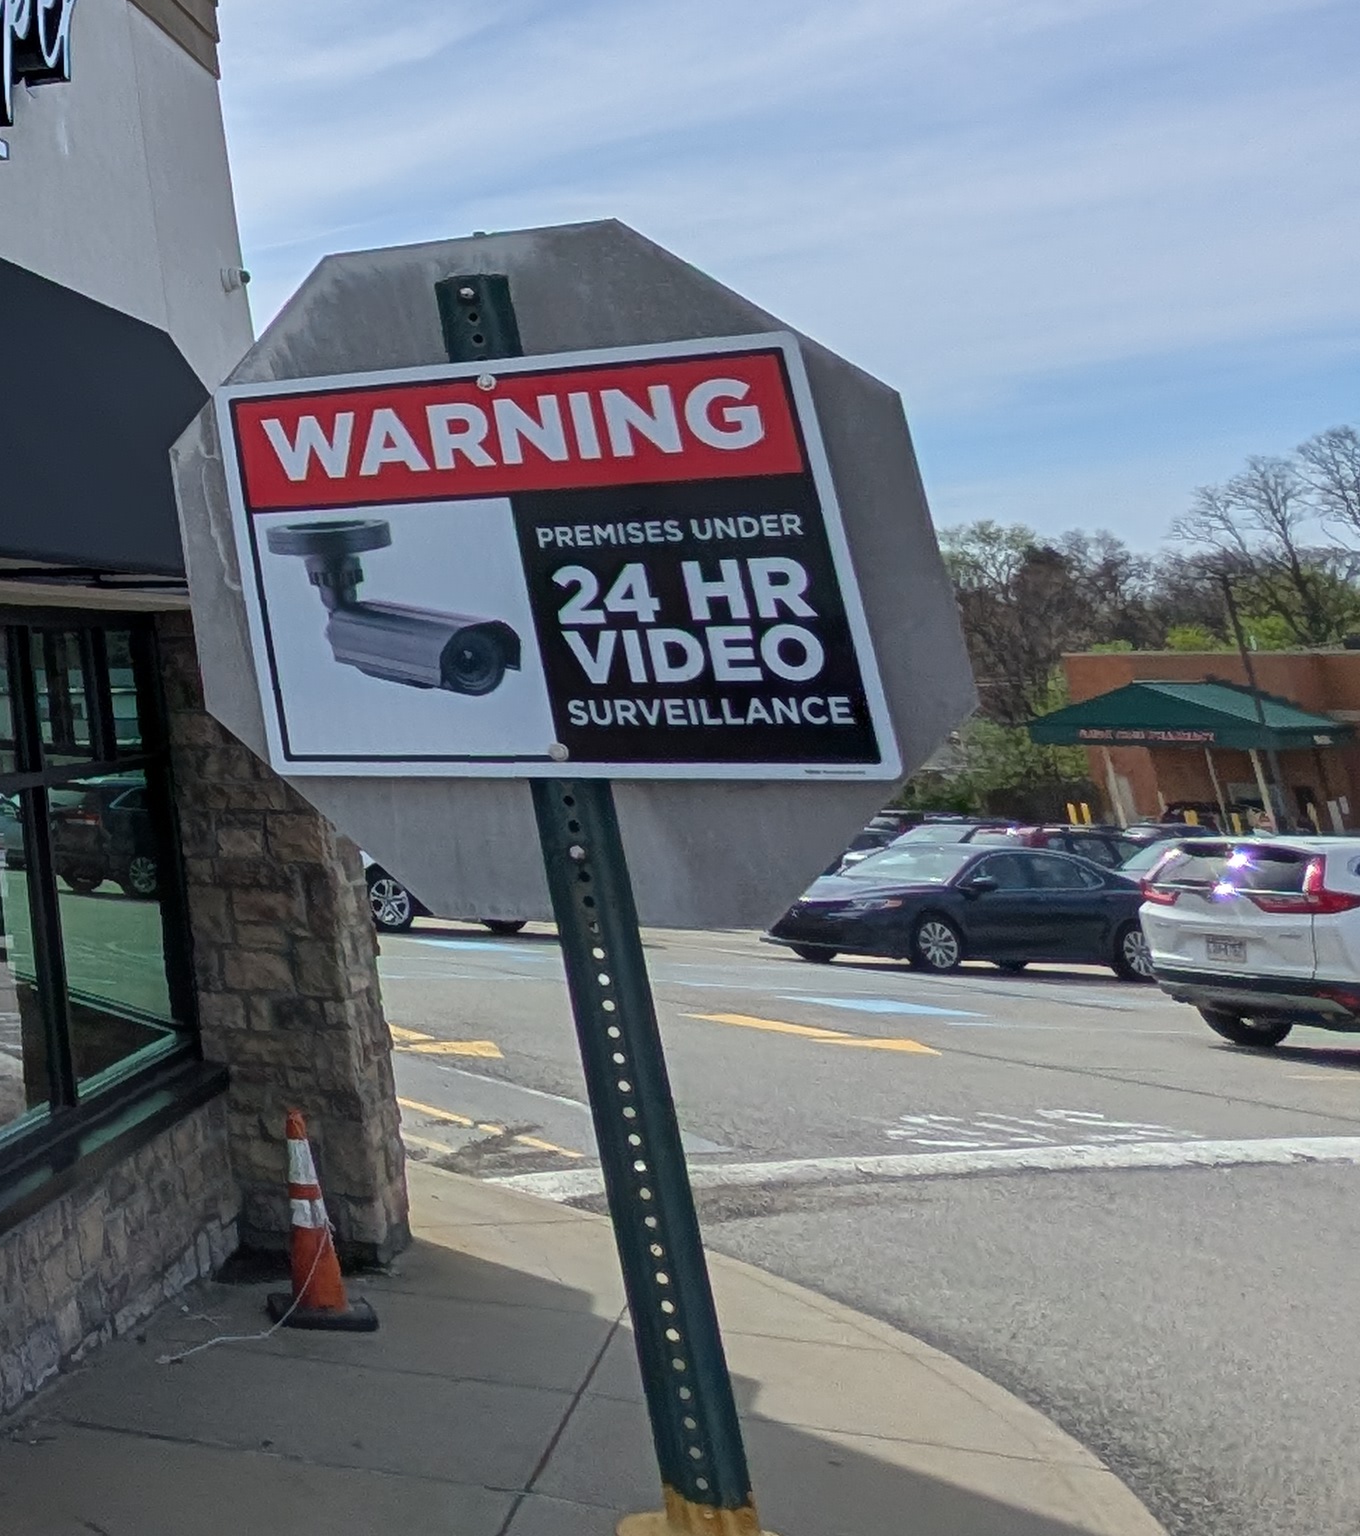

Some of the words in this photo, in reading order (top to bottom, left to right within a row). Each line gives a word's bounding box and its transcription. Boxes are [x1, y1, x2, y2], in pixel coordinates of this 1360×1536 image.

[259, 377, 766, 483] WARNING
[536, 519, 684, 549] PREMISES
[690, 513, 804, 541] UNDER
[551, 562, 661, 625] 24
[681, 556, 819, 621] HR
[560, 623, 825, 685] VIDEO
[567, 696, 855, 726] SURVEILLANCE
